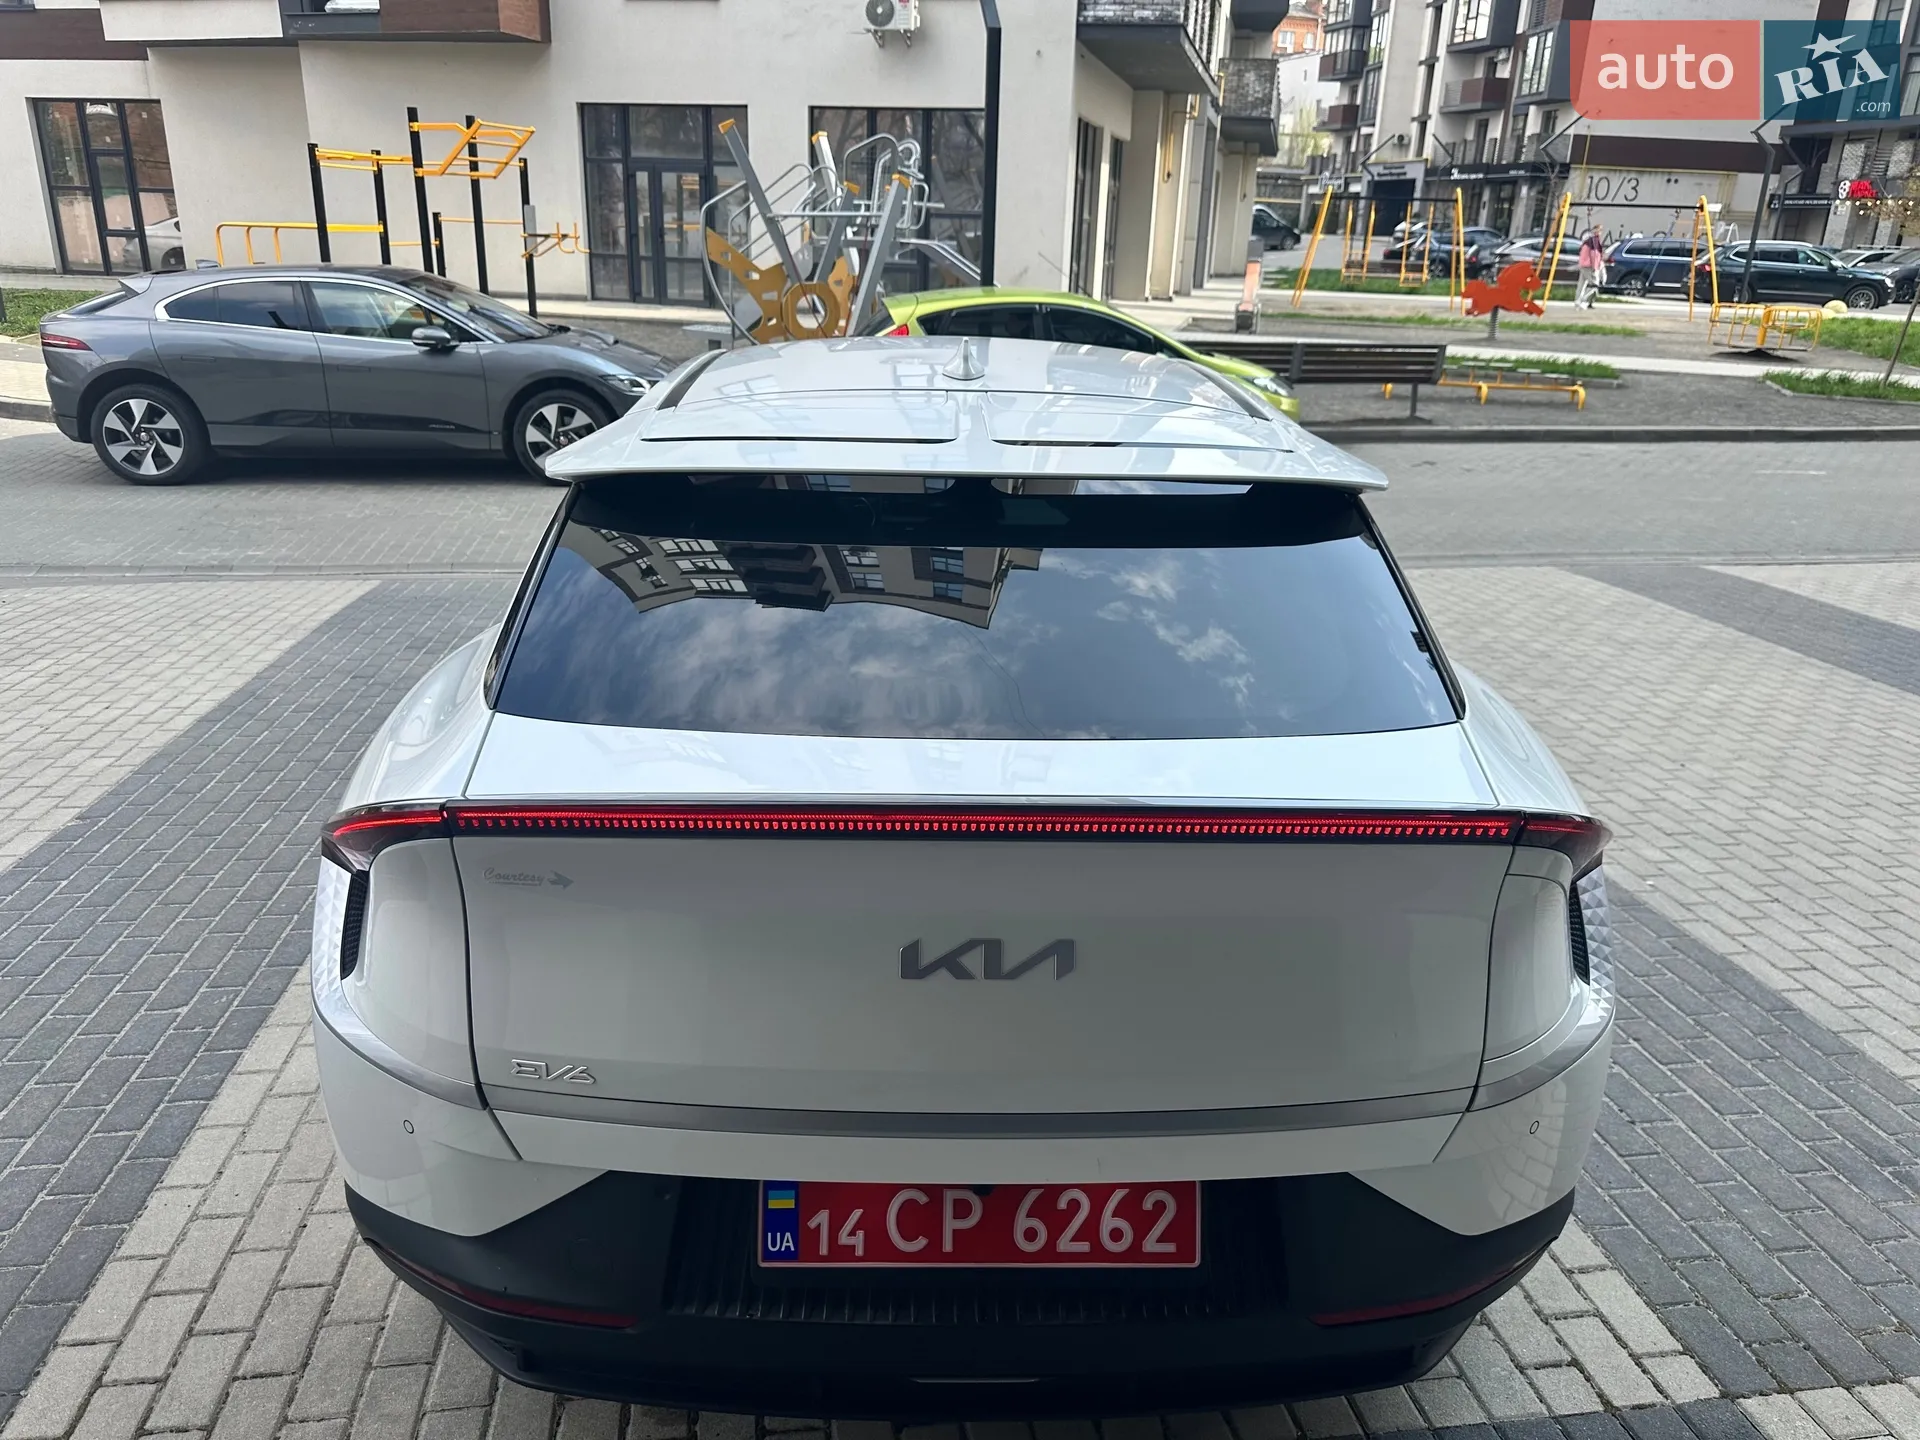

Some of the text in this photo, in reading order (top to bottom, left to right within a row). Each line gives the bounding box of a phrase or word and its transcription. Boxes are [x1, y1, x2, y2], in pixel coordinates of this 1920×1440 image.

[1587, 175, 1640, 202] 10/3
[483, 867, 546, 886] Courtesy
[899, 937, 1076, 981] KIA
[510, 1058, 596, 1084] EV6
[807, 1188, 1177, 1256] 14 CP 6262
[767, 1231, 795, 1252] UA
